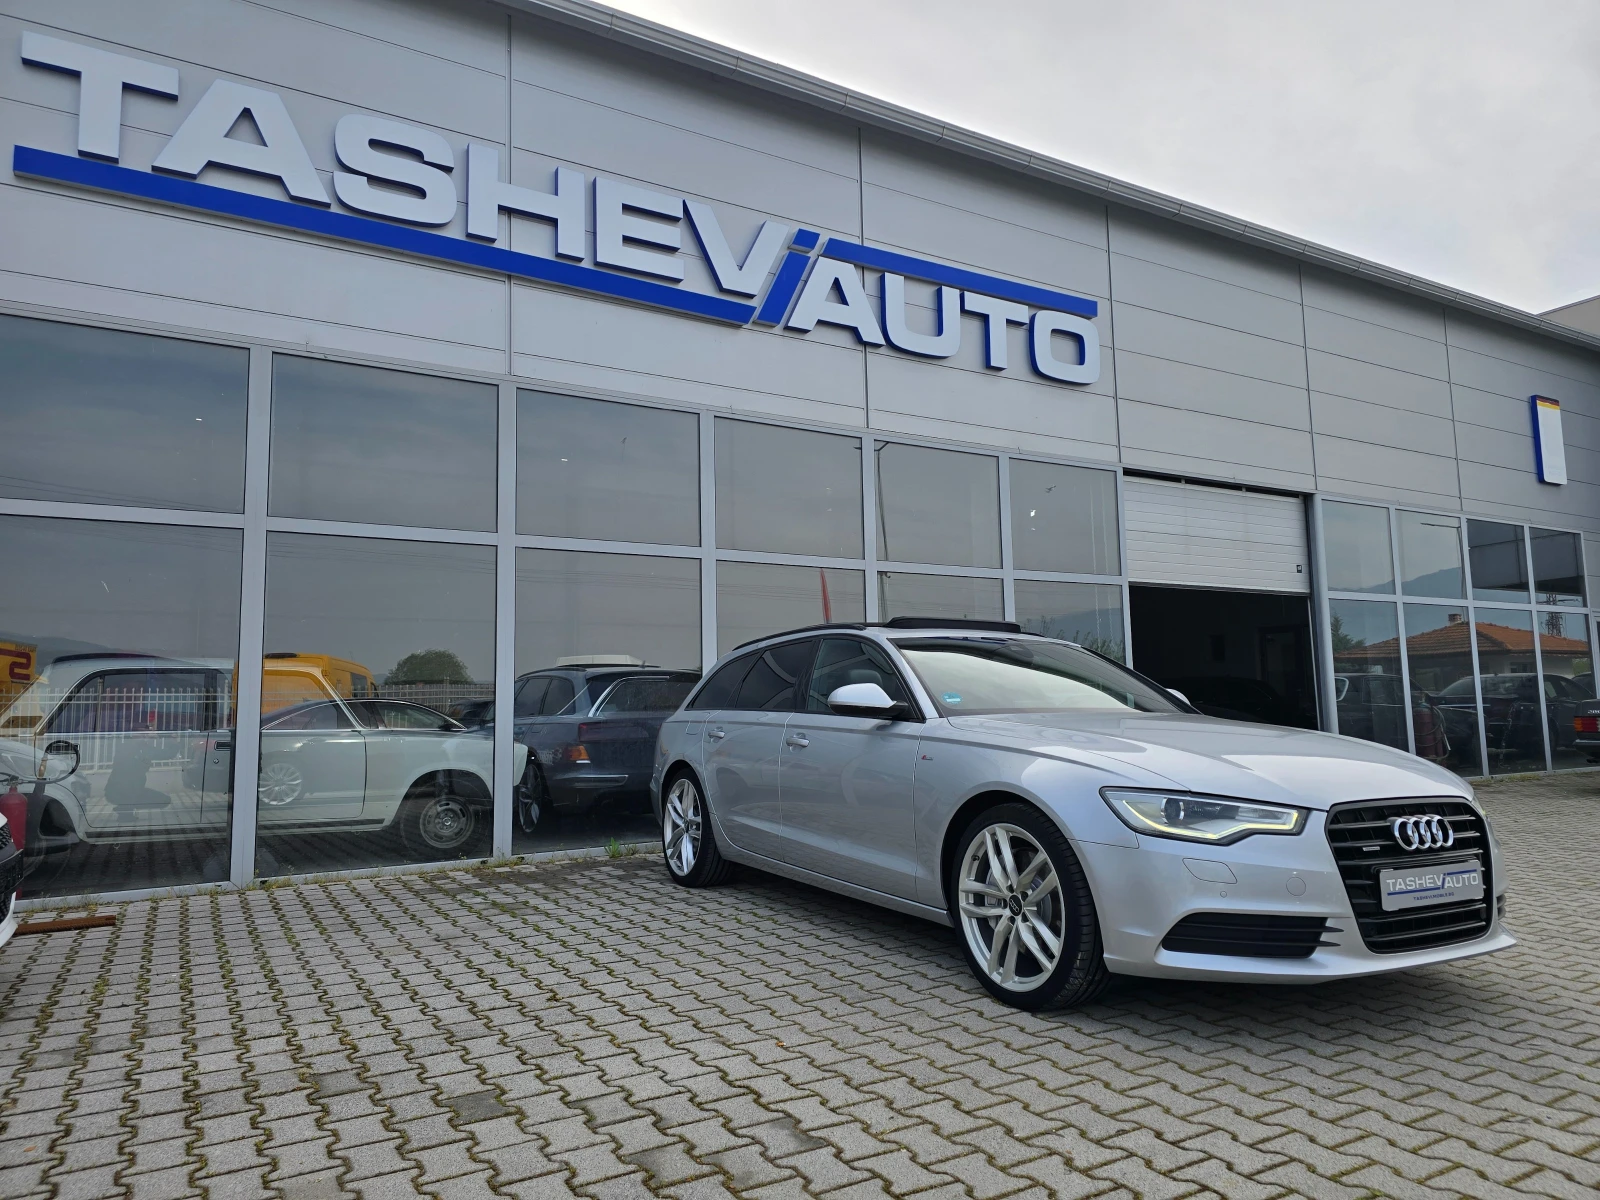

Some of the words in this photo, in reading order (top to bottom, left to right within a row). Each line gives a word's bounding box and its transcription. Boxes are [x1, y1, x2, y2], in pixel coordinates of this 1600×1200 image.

[21, 30, 789, 298] TASHEV
[783, 256, 1101, 385] AUTO
[1386, 873, 1443, 892] TASHEV
[1444, 873, 1479, 889] AUTO
